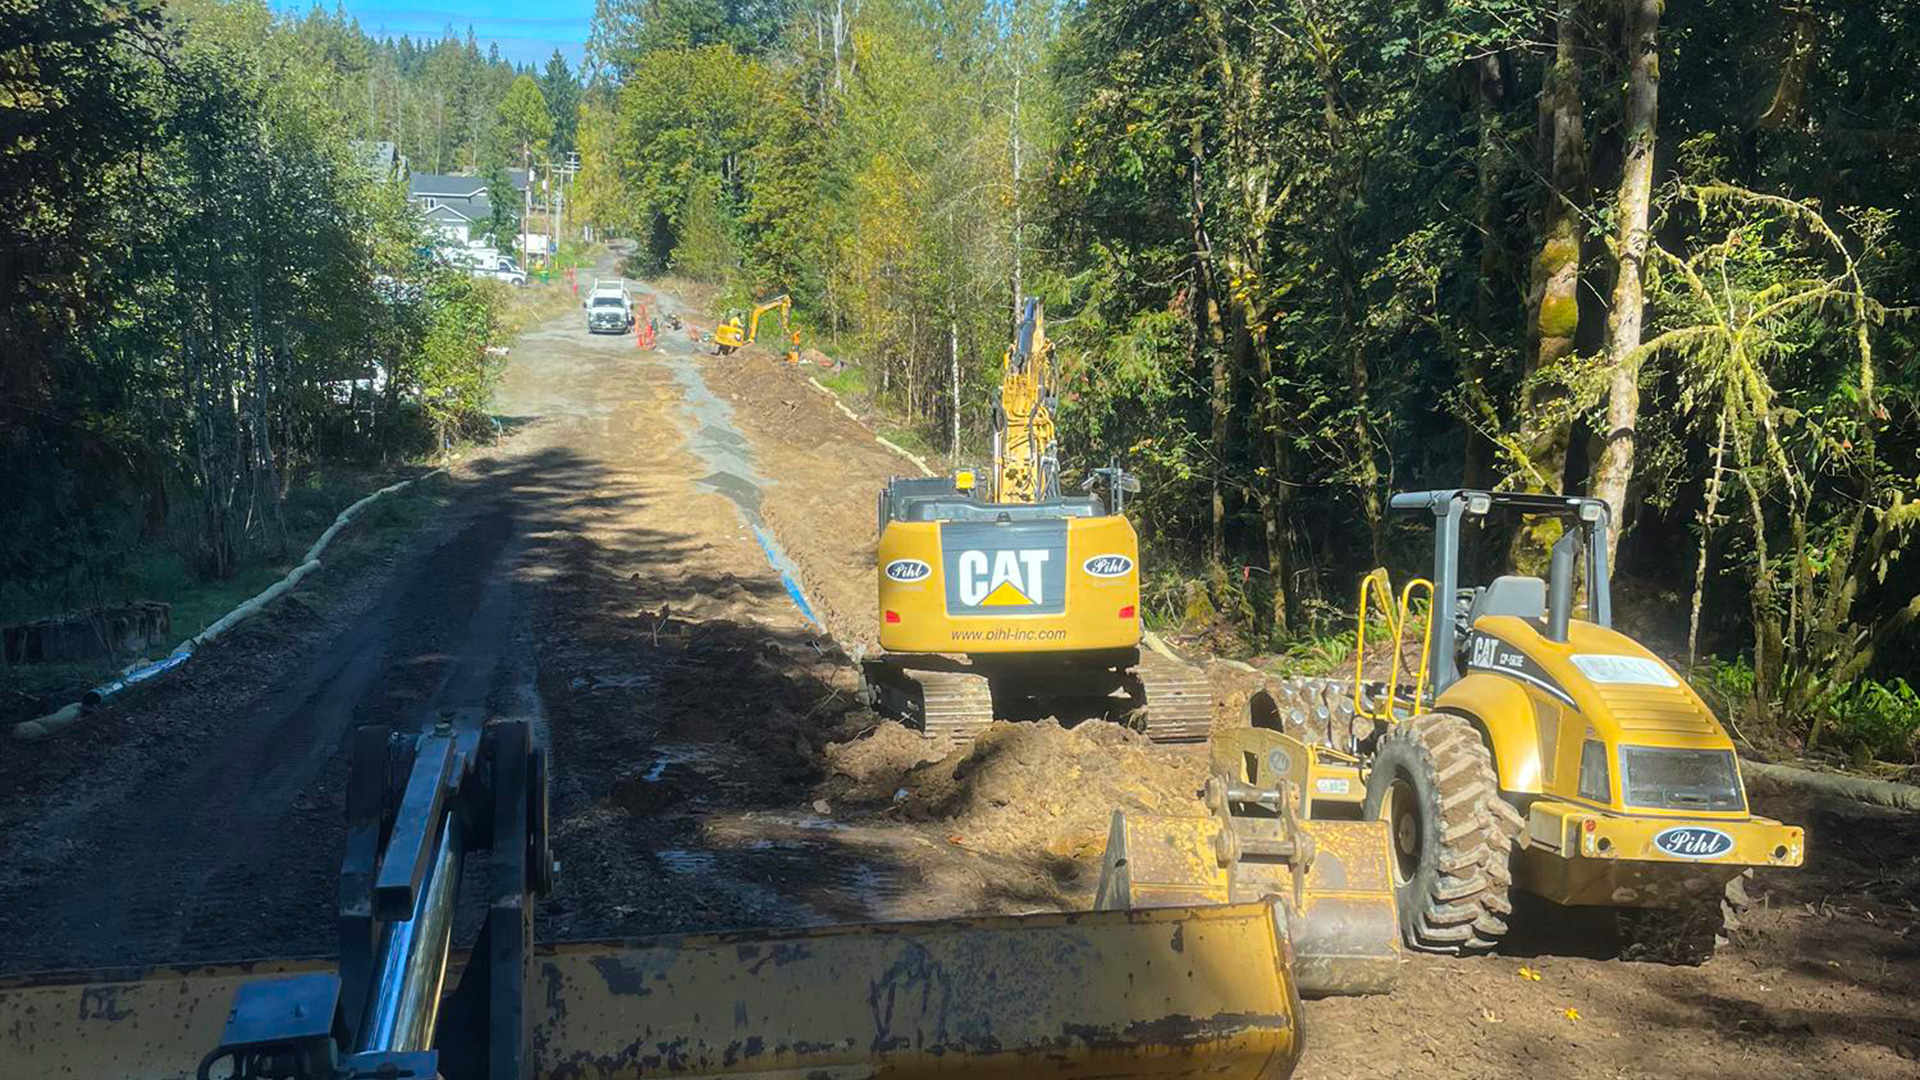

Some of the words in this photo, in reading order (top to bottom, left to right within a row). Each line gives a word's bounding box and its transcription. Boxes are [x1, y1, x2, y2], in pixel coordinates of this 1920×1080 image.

[892, 562, 923, 578] Pihl
[1092, 558, 1126, 573] Pihl
[959, 550, 1049, 607] CAT
[1473, 636, 1499, 668] CAT
[1666, 831, 1721, 853] Pihl
